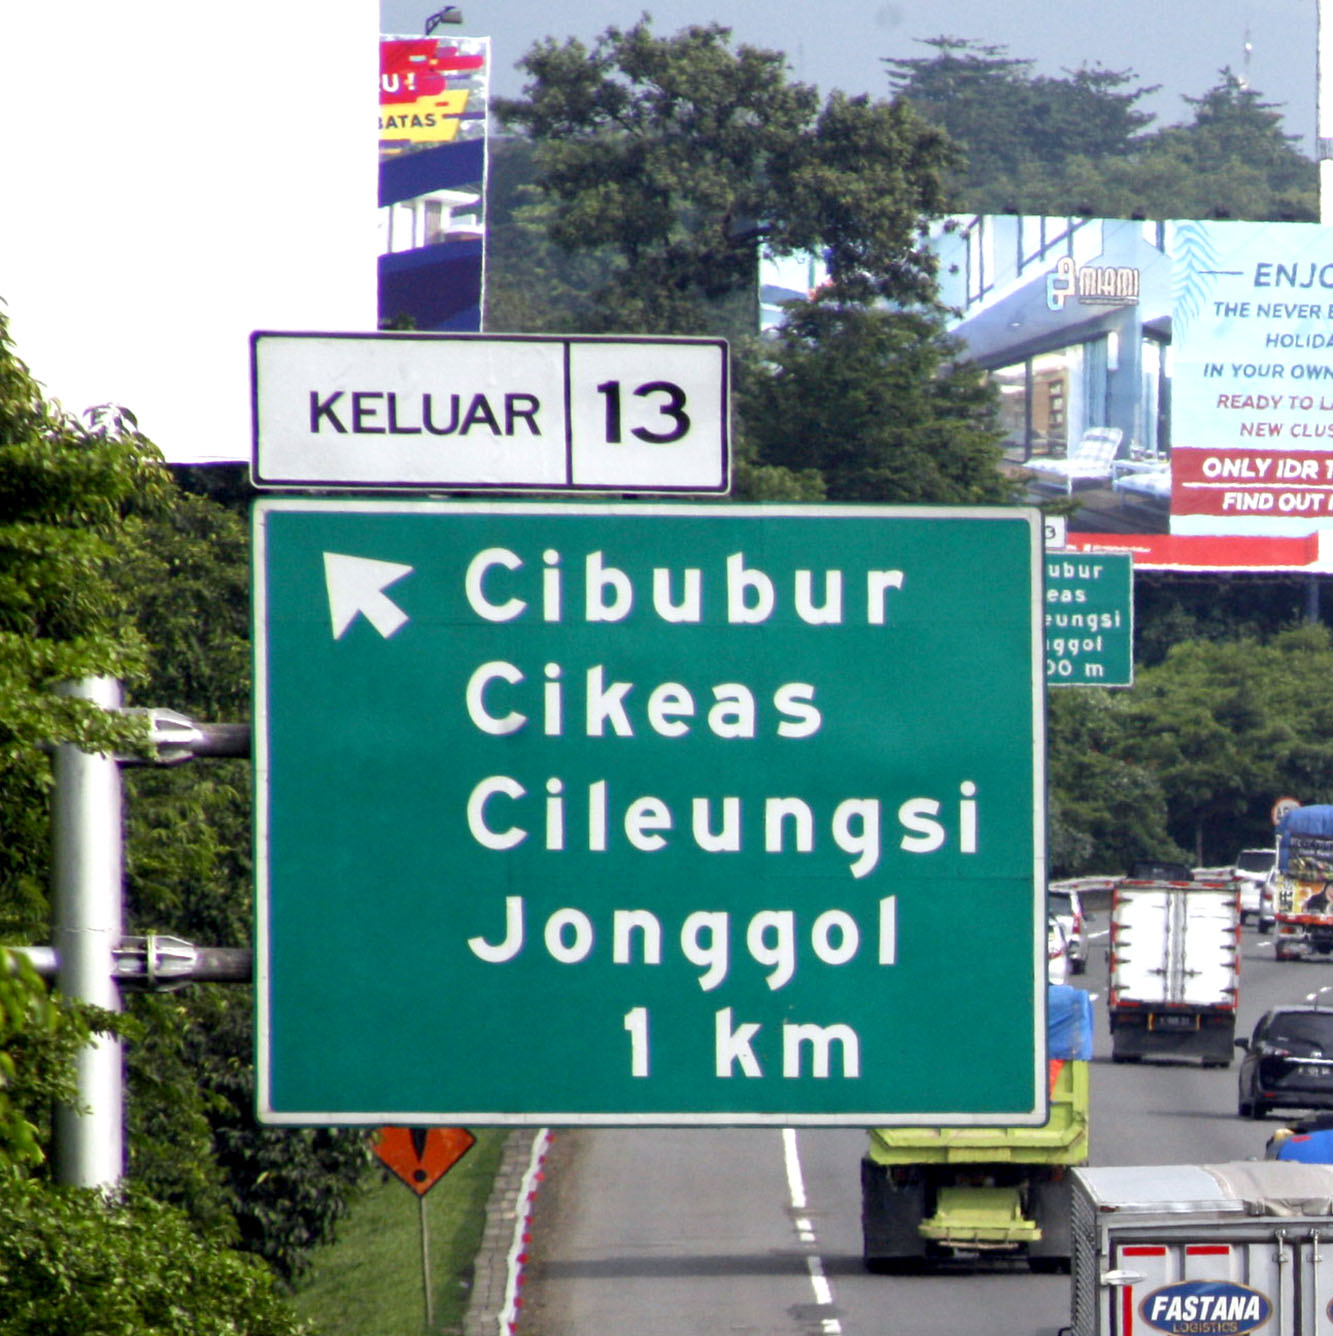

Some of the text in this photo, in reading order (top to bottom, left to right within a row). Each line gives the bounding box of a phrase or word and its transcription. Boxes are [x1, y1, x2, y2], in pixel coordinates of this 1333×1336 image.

[1079, 266, 1140, 297] MIAMI
[1214, 301, 1250, 318] THE
[1256, 303, 1321, 319] NEVER
[1203, 363, 1224, 378] IN
[1231, 363, 1284, 380] YOUR
[309, 381, 691, 445] KELUAR 13
[1216, 394, 1283, 411] READY
[1288, 395, 1314, 411] TO
[1239, 422, 1283, 438] NEW
[1202, 457, 1272, 478] ONLY
[1276, 458, 1318, 479] IDR
[1222, 491, 1274, 511] FIND
[1278, 493, 1324, 512] OUT
[465, 547, 905, 625] Cibubur
[1085, 663, 1104, 677] m
[465, 660, 823, 738] Cikeas
[466, 774, 979, 880] Cileungsi
[467, 895, 898, 991] Jonggol
[623, 1006, 861, 1079] 1 km
[1150, 1295, 1261, 1321] FASTANA
[1173, 1322, 1238, 1333] LOGISTICS
